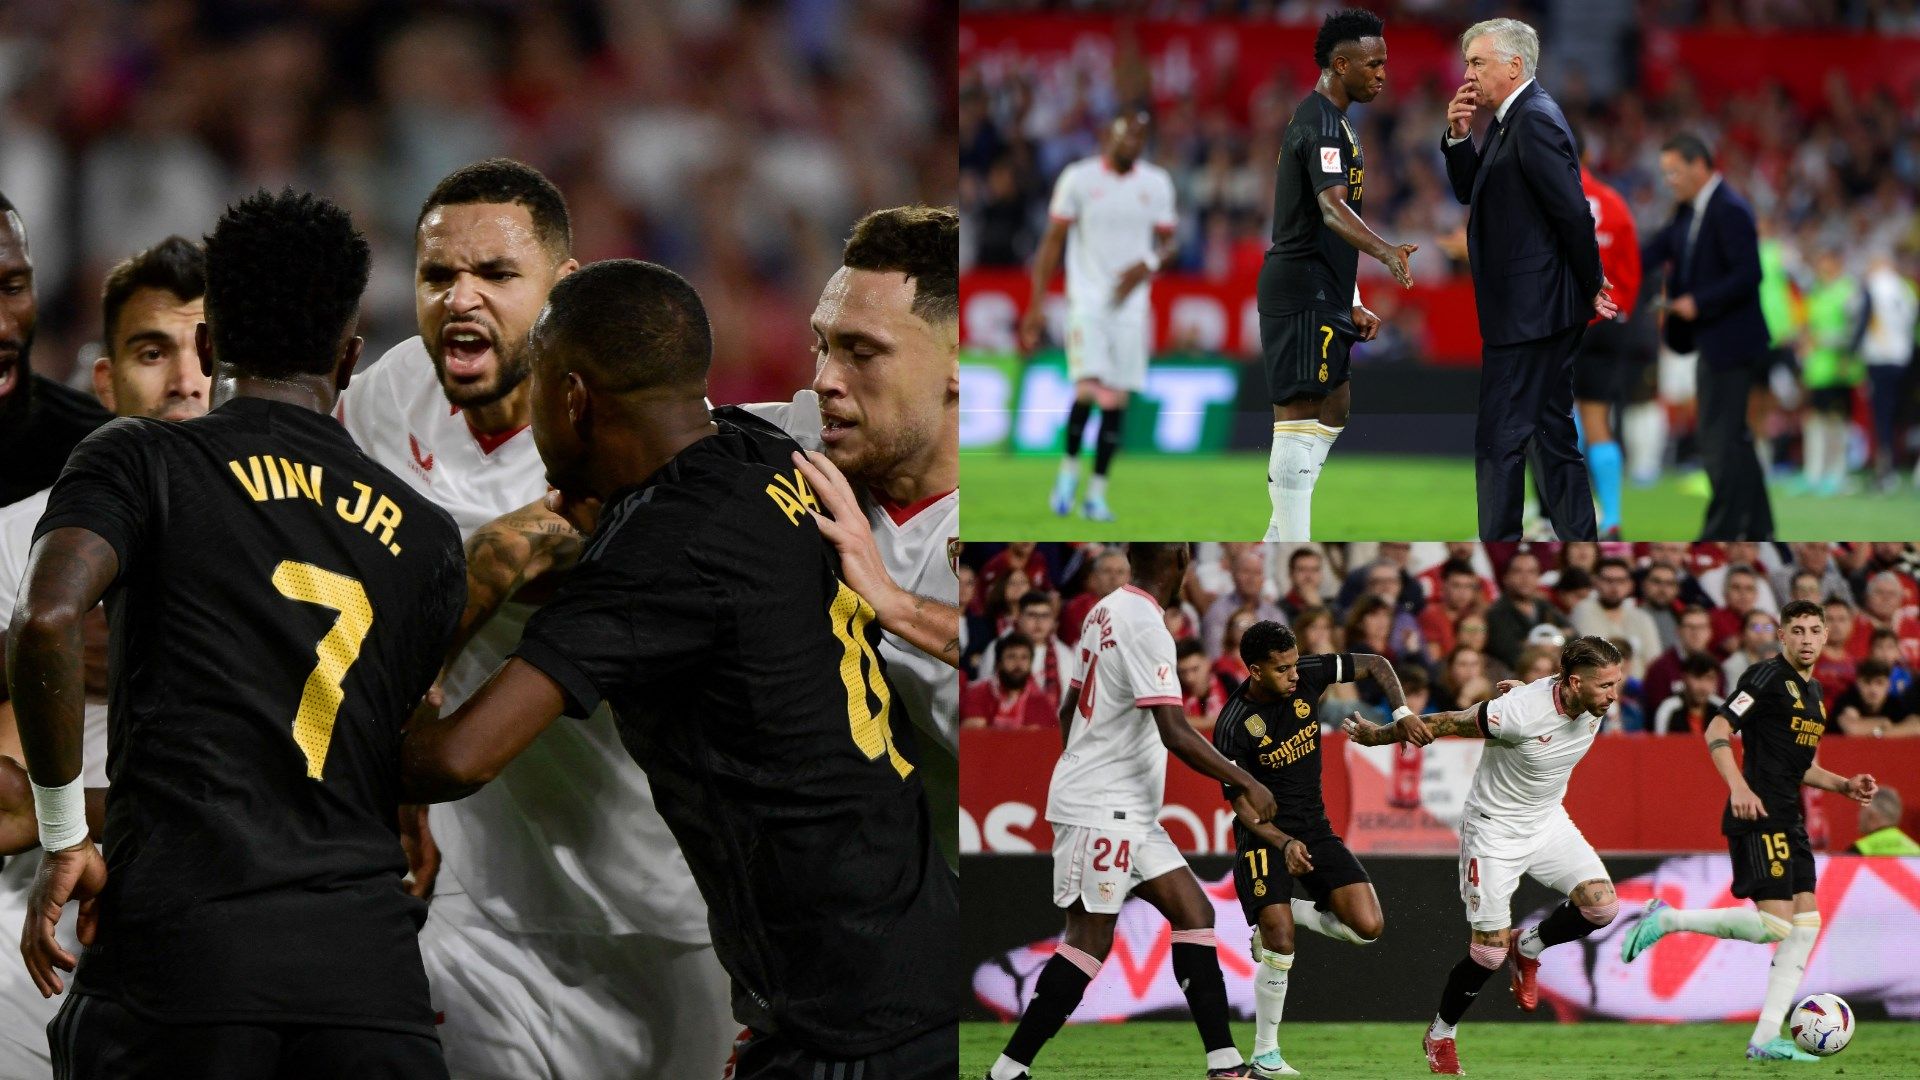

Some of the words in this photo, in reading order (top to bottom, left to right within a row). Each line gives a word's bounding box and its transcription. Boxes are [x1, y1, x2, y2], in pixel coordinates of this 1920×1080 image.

[1320, 325, 1334, 359] 7
[228, 454, 324, 507] VINI
[335, 480, 403, 558] JR.
[765, 468, 820, 527] ALA
[271, 559, 374, 782] 7
[1259, 720, 1319, 766] Emirates
[1092, 837, 1130, 873] 24
[1245, 848, 1269, 879] 11
[1761, 832, 1790, 861] 15
[1467, 857, 1480, 888] 4
